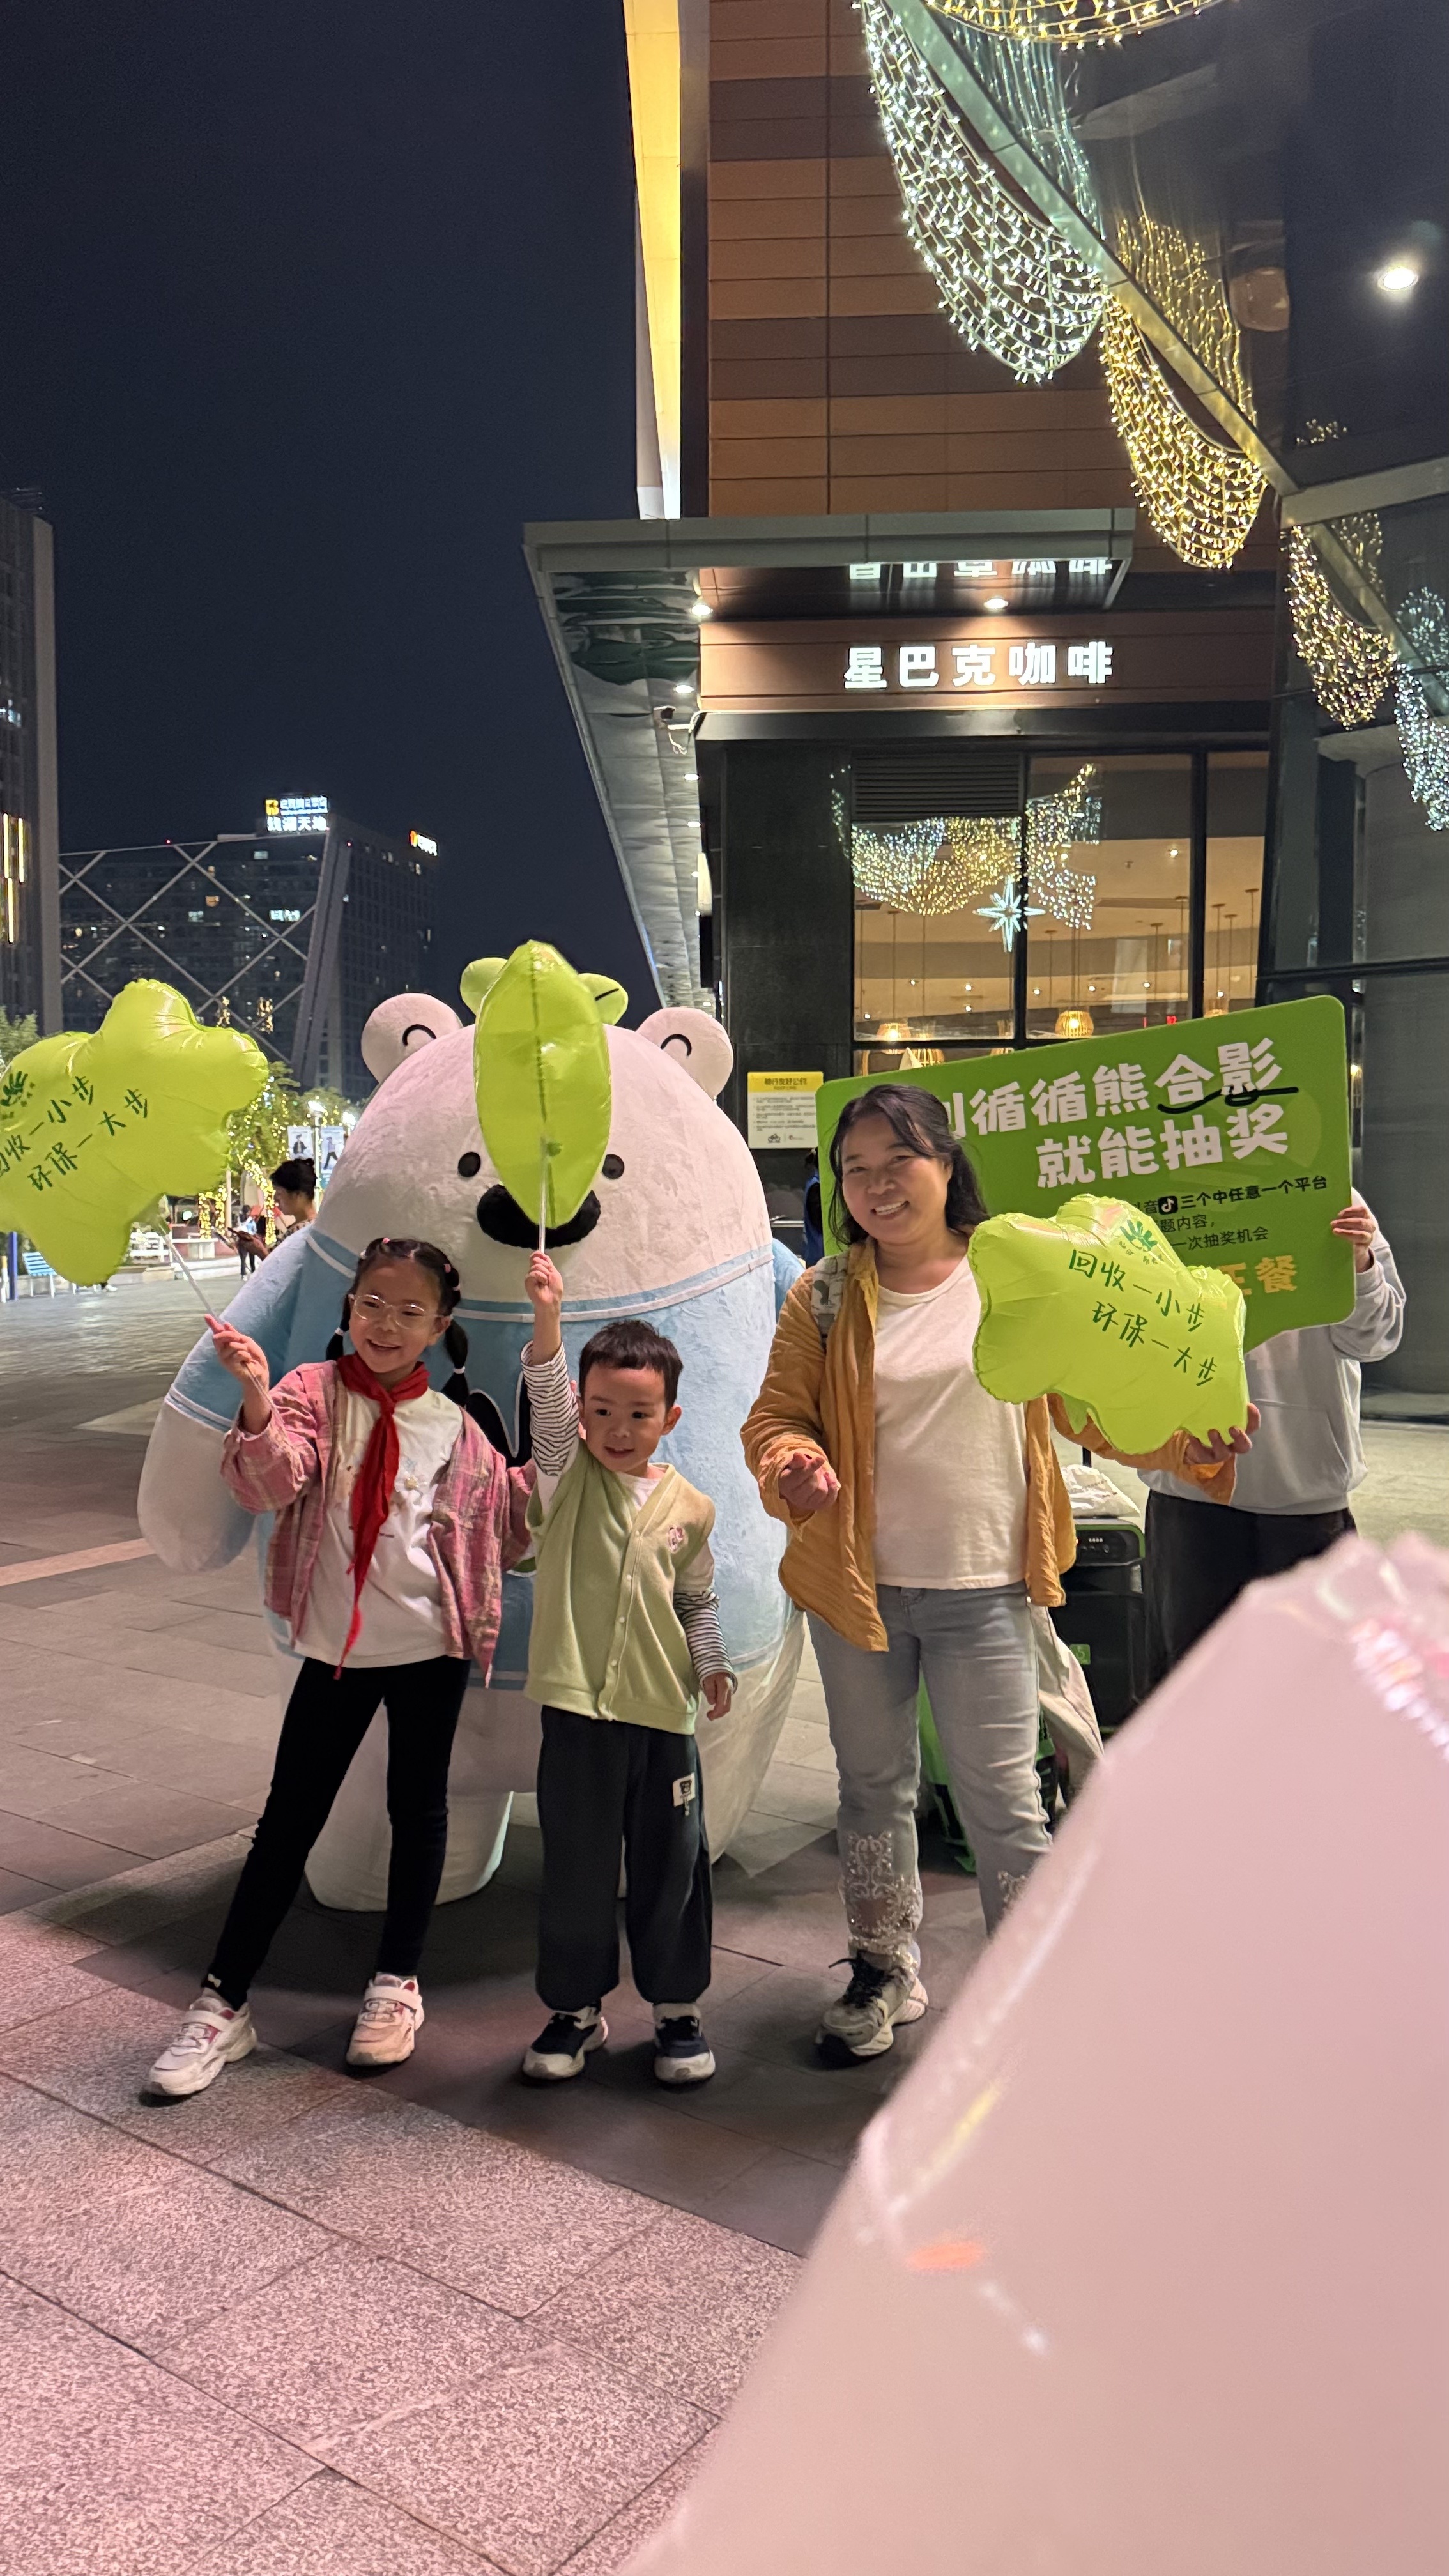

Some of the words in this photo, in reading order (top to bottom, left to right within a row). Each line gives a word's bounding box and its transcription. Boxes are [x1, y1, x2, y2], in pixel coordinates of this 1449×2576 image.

[844, 641, 1113, 689] 星巴克咖啡
[27, 1089, 148, 1191] 环保一大步
[1036, 1103, 1289, 1189] 就能抽奖
[1155, 1213, 1215, 1233] 题内容，
[1181, 1175, 1328, 1209] 三个中任意一个平台
[1172, 1226, 1269, 1250] 一次抽奖机会
[1069, 1249, 1206, 1332] 回收一小步
[1092, 1301, 1217, 1386] 环保一大步
